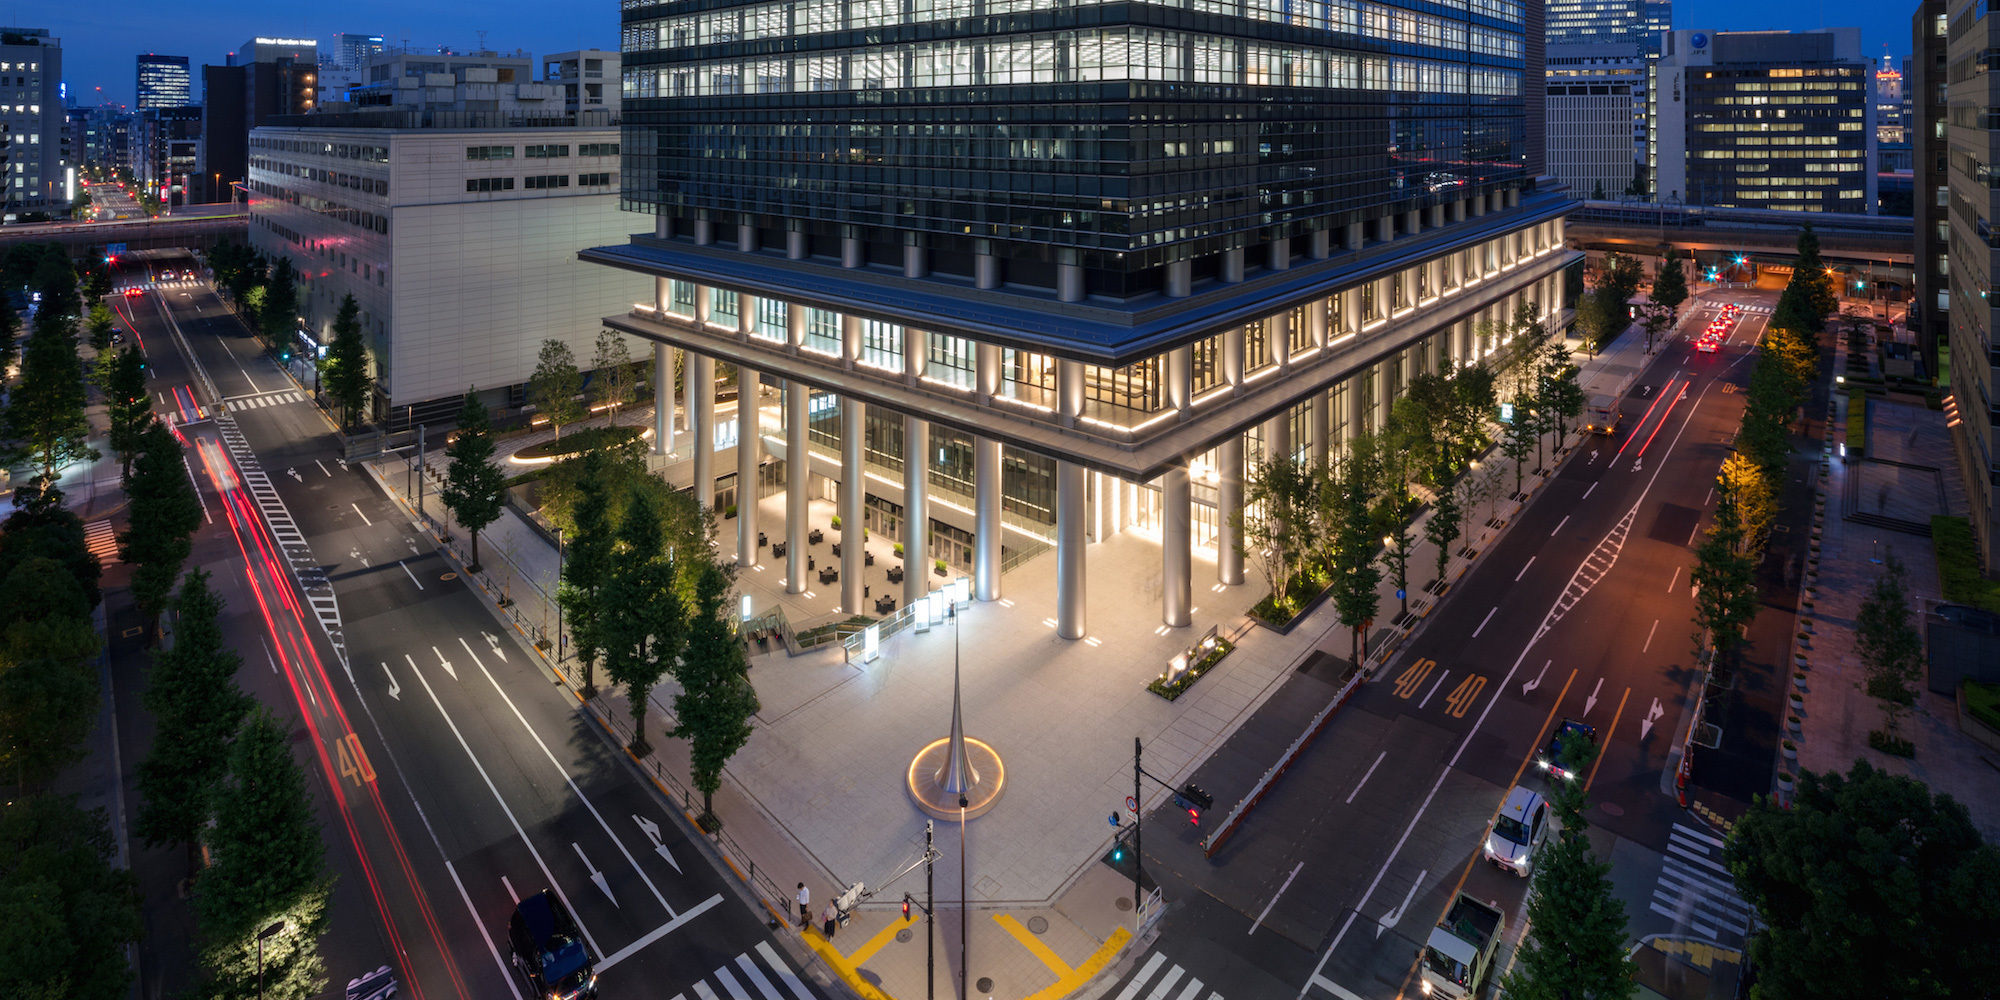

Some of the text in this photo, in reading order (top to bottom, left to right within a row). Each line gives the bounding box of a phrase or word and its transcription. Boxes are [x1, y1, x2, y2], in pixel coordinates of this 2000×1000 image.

[277, 38, 299, 46] Garden
[1392, 657, 1436, 699] 40
[1444, 673, 1488, 718] 40
[336, 733, 377, 787] 40
